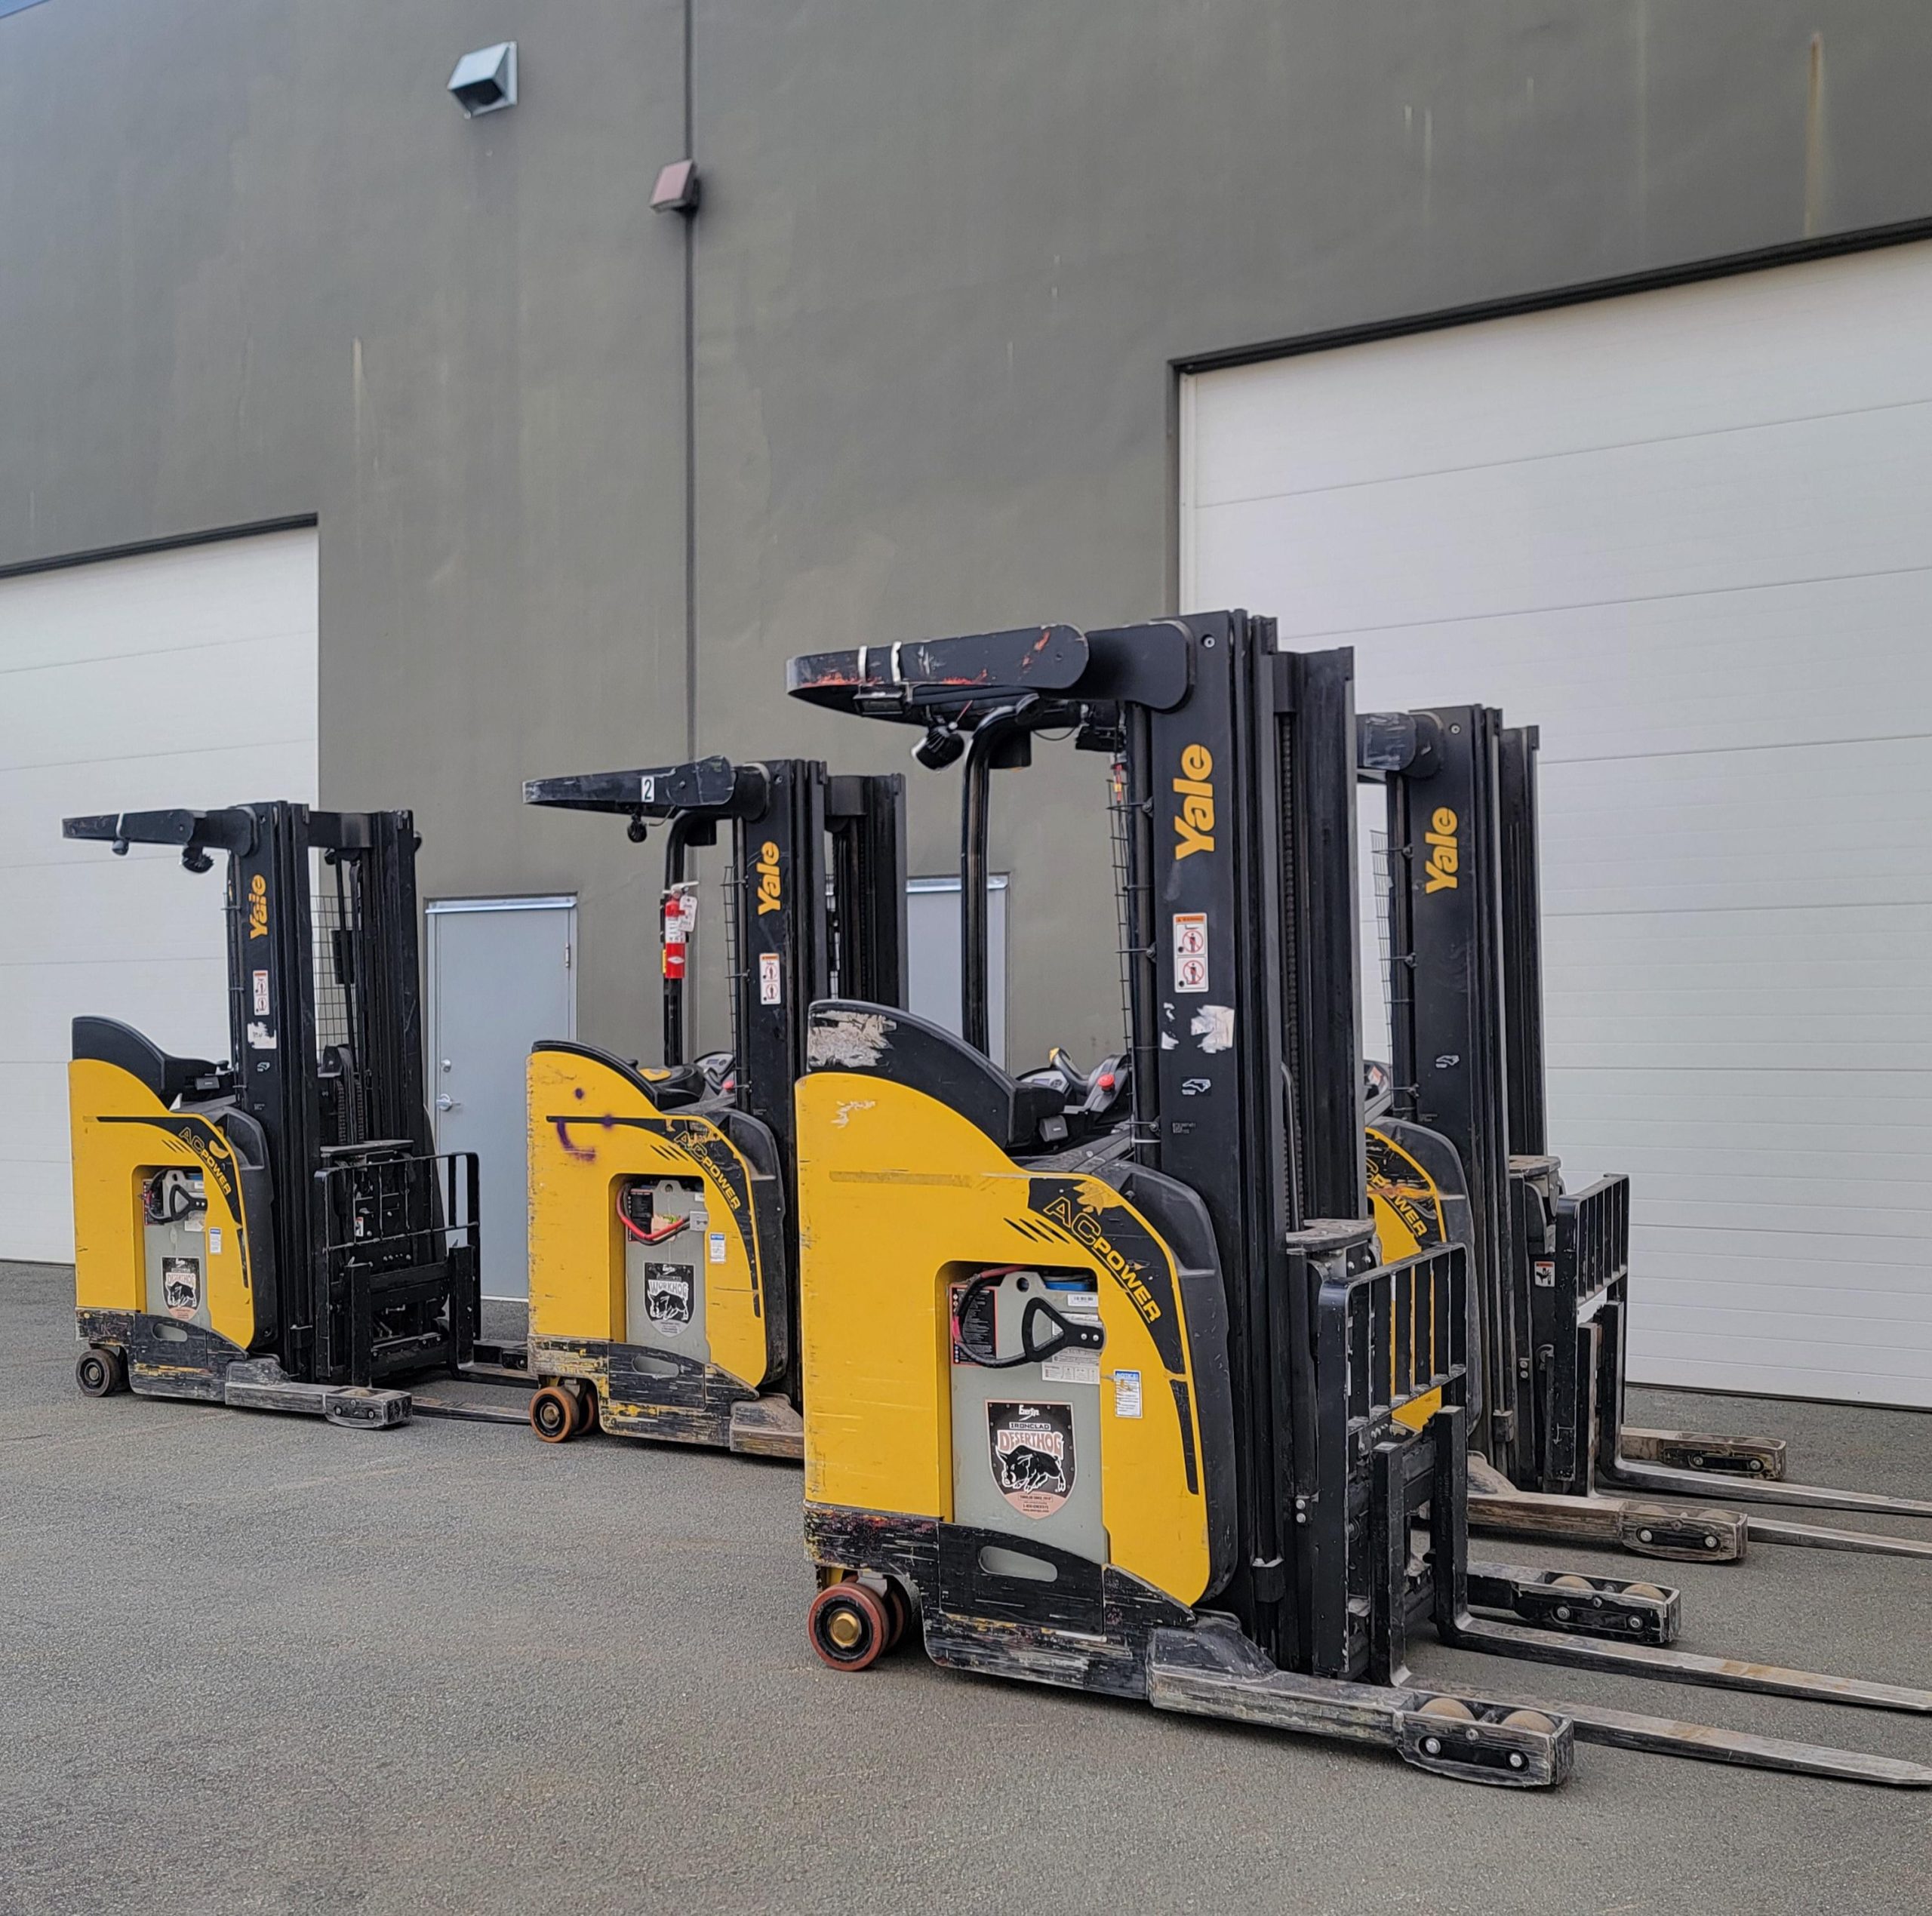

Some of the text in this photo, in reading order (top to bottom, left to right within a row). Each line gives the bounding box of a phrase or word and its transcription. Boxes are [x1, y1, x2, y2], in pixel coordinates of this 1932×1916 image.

[645, 779, 651, 800] 2
[1173, 743, 1214, 860] Yale
[756, 841, 780, 915] Yale
[1425, 807, 1458, 894] Yale
[248, 875, 267, 940] Yale
[179, 1127, 232, 1195] AC POWER
[703, 1156, 740, 1209] POWER
[1372, 1173, 1428, 1237] PWER
[1043, 1196, 1162, 1322] AC POWER
[998, 1431, 1063, 1459] DESERTHOG
